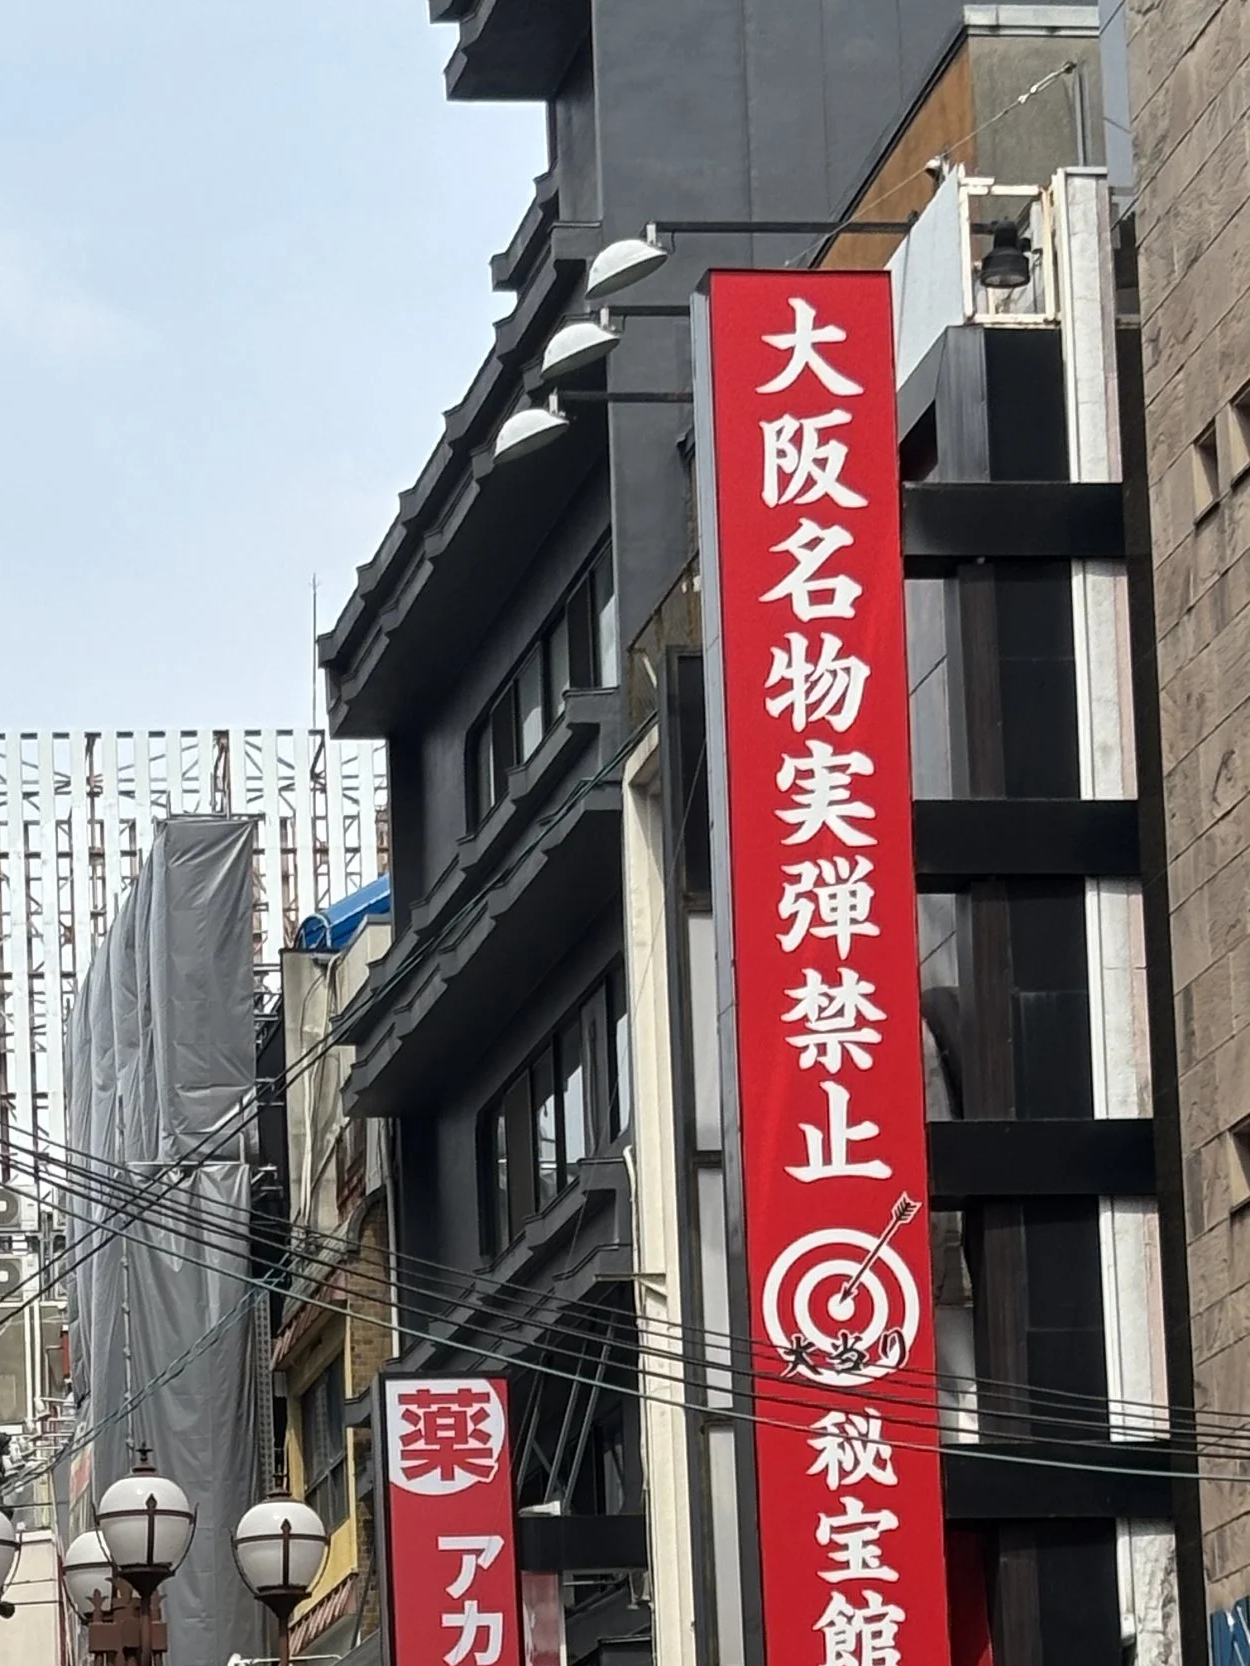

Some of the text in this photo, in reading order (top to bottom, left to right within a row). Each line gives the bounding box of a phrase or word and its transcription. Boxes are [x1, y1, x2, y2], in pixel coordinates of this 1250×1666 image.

[754, 297, 892, 1184] 大阪名物実弾禁止
[397, 1387, 499, 1483] 薬
